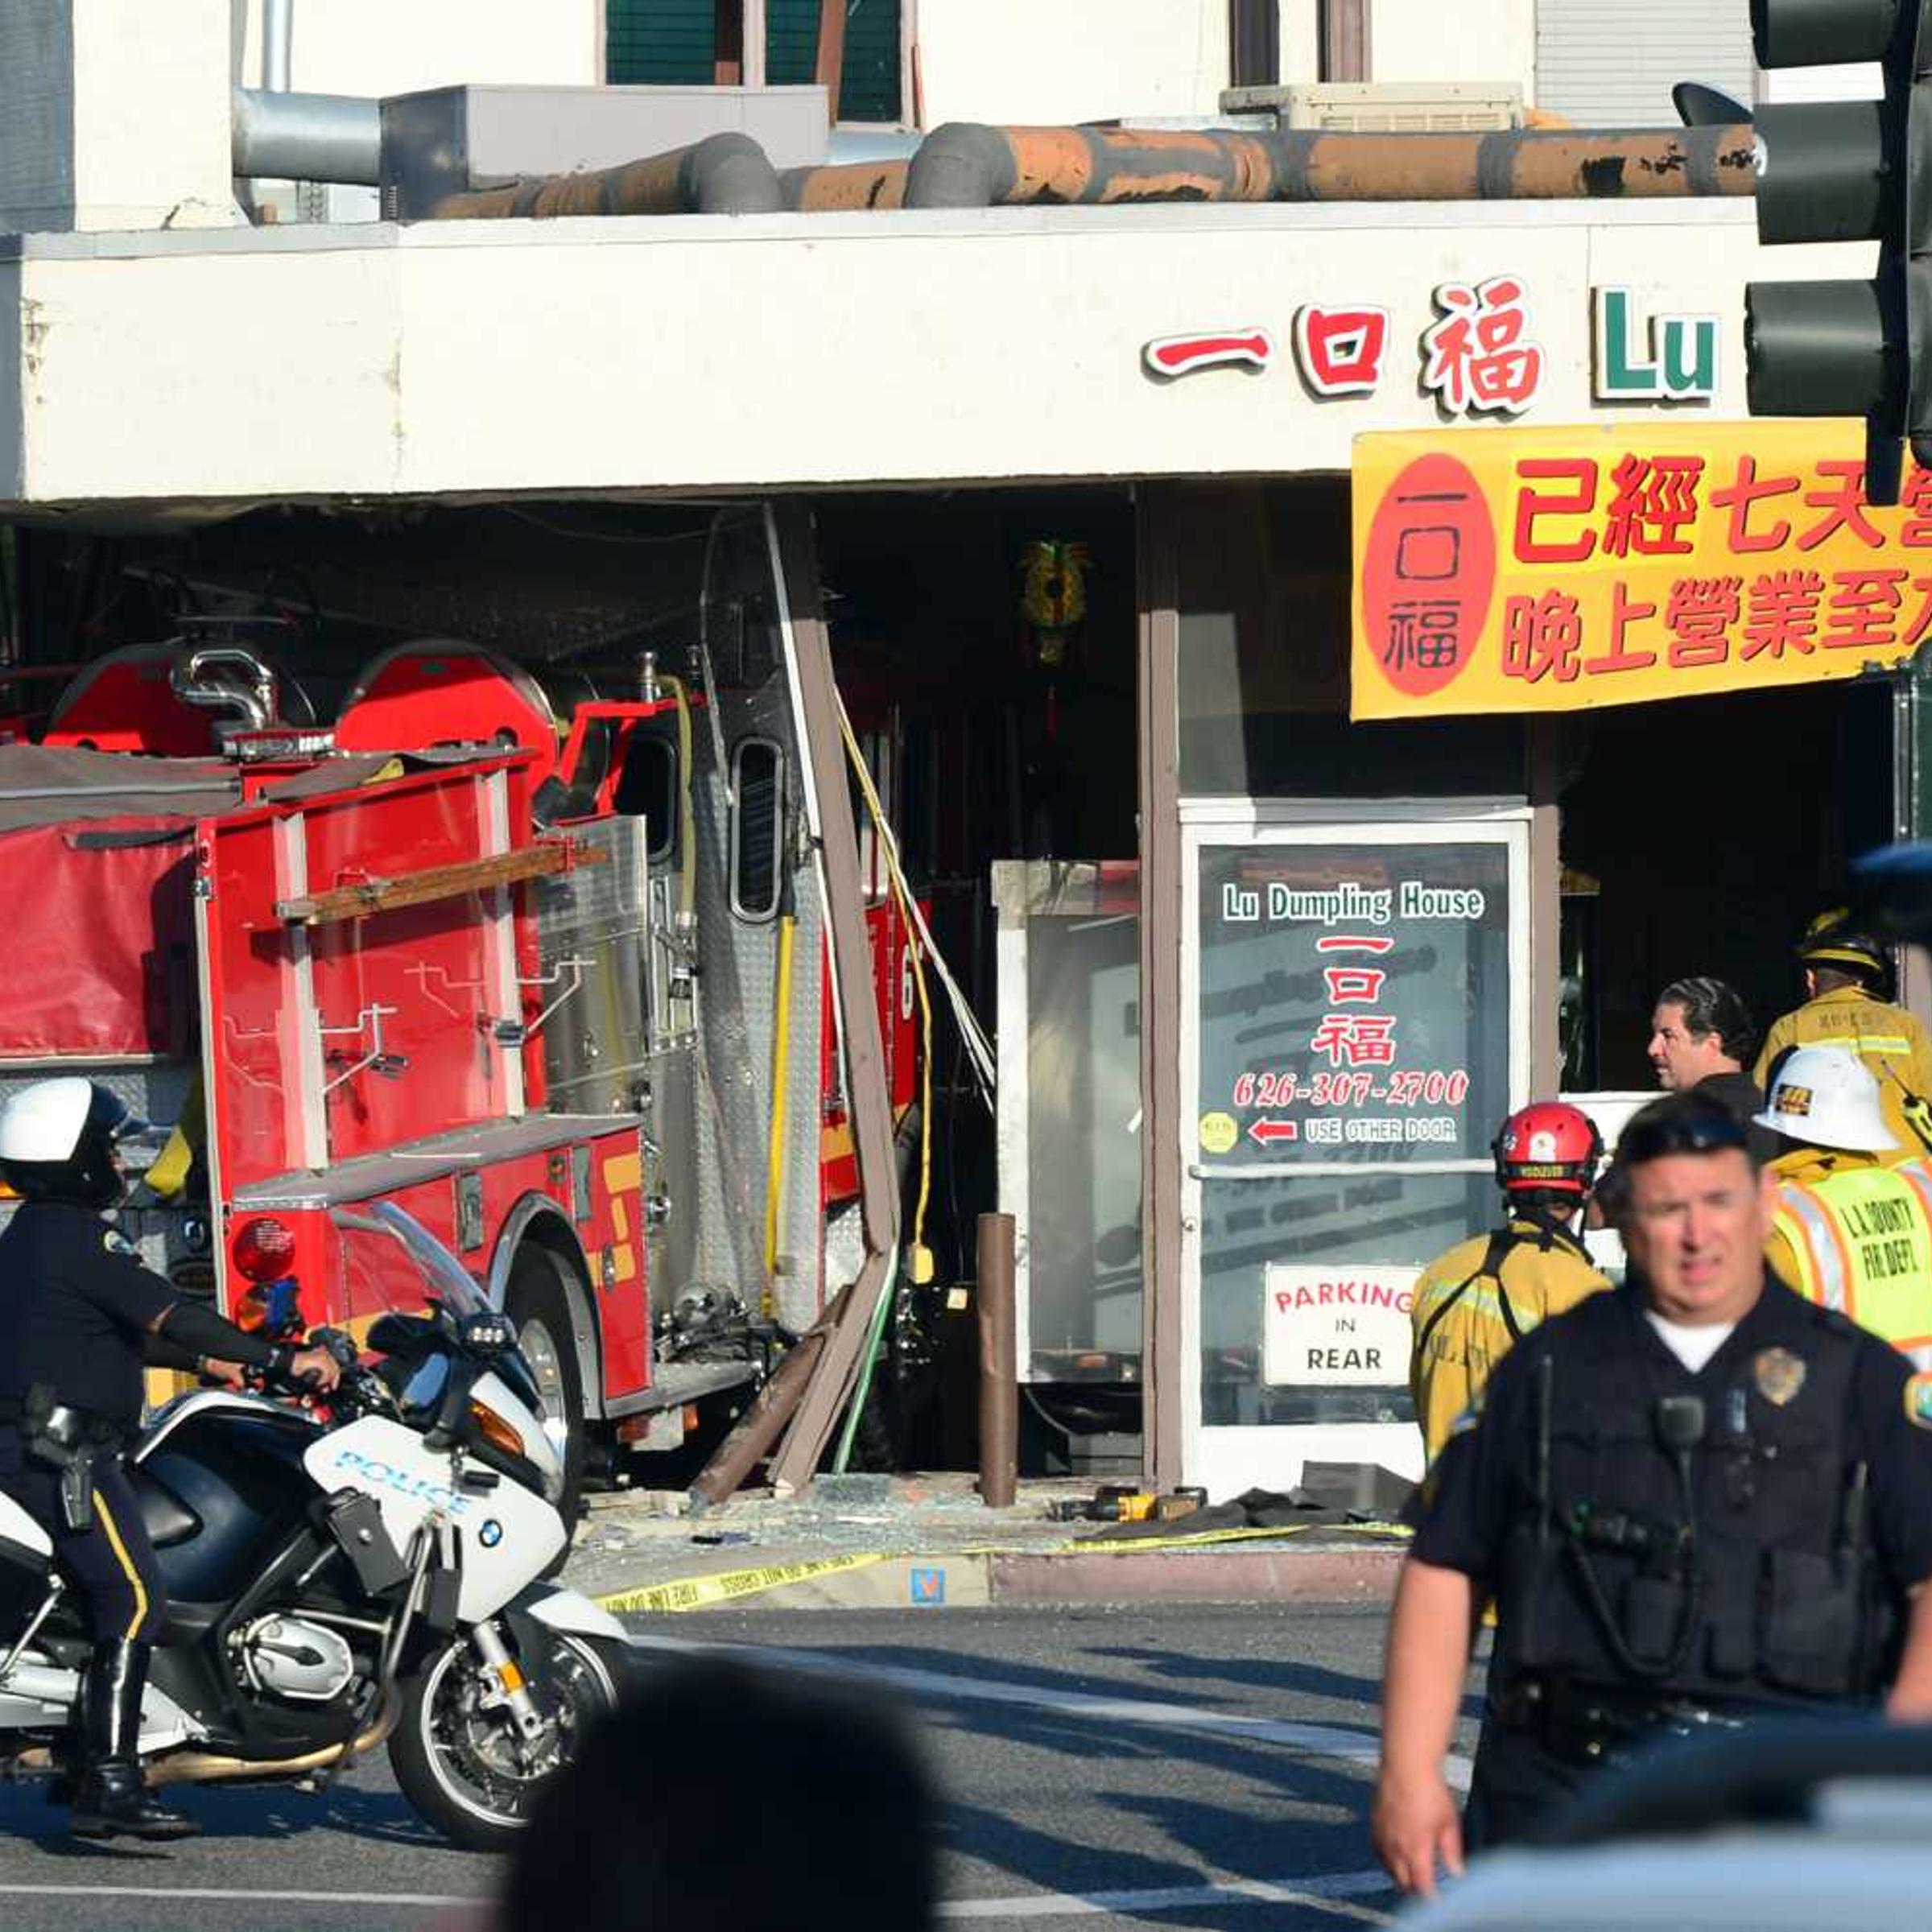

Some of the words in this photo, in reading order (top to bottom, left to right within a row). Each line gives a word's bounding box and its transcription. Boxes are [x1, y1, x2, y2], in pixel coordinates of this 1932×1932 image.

[1147, 275, 1542, 409] 一口福
[1603, 288, 1716, 394] Lu
[1384, 493, 1467, 671] 一口福
[1224, 885, 1257, 919] Lu
[1269, 885, 1391, 924] Dumpling
[1402, 883, 1483, 919] House
[1313, 937, 1395, 1065] 一口福
[1234, 1070, 1469, 1108] 626-307-2700
[1306, 1120, 1342, 1141] USE
[1346, 1120, 1402, 1141] OTHER
[1406, 1119, 1456, 1141] DOOR
[1275, 1282, 1413, 1314] PARKING
[1335, 1318, 1356, 1333] IN
[1307, 1348, 1382, 1370] REAR
[334, 1450, 473, 1514] POLICE
